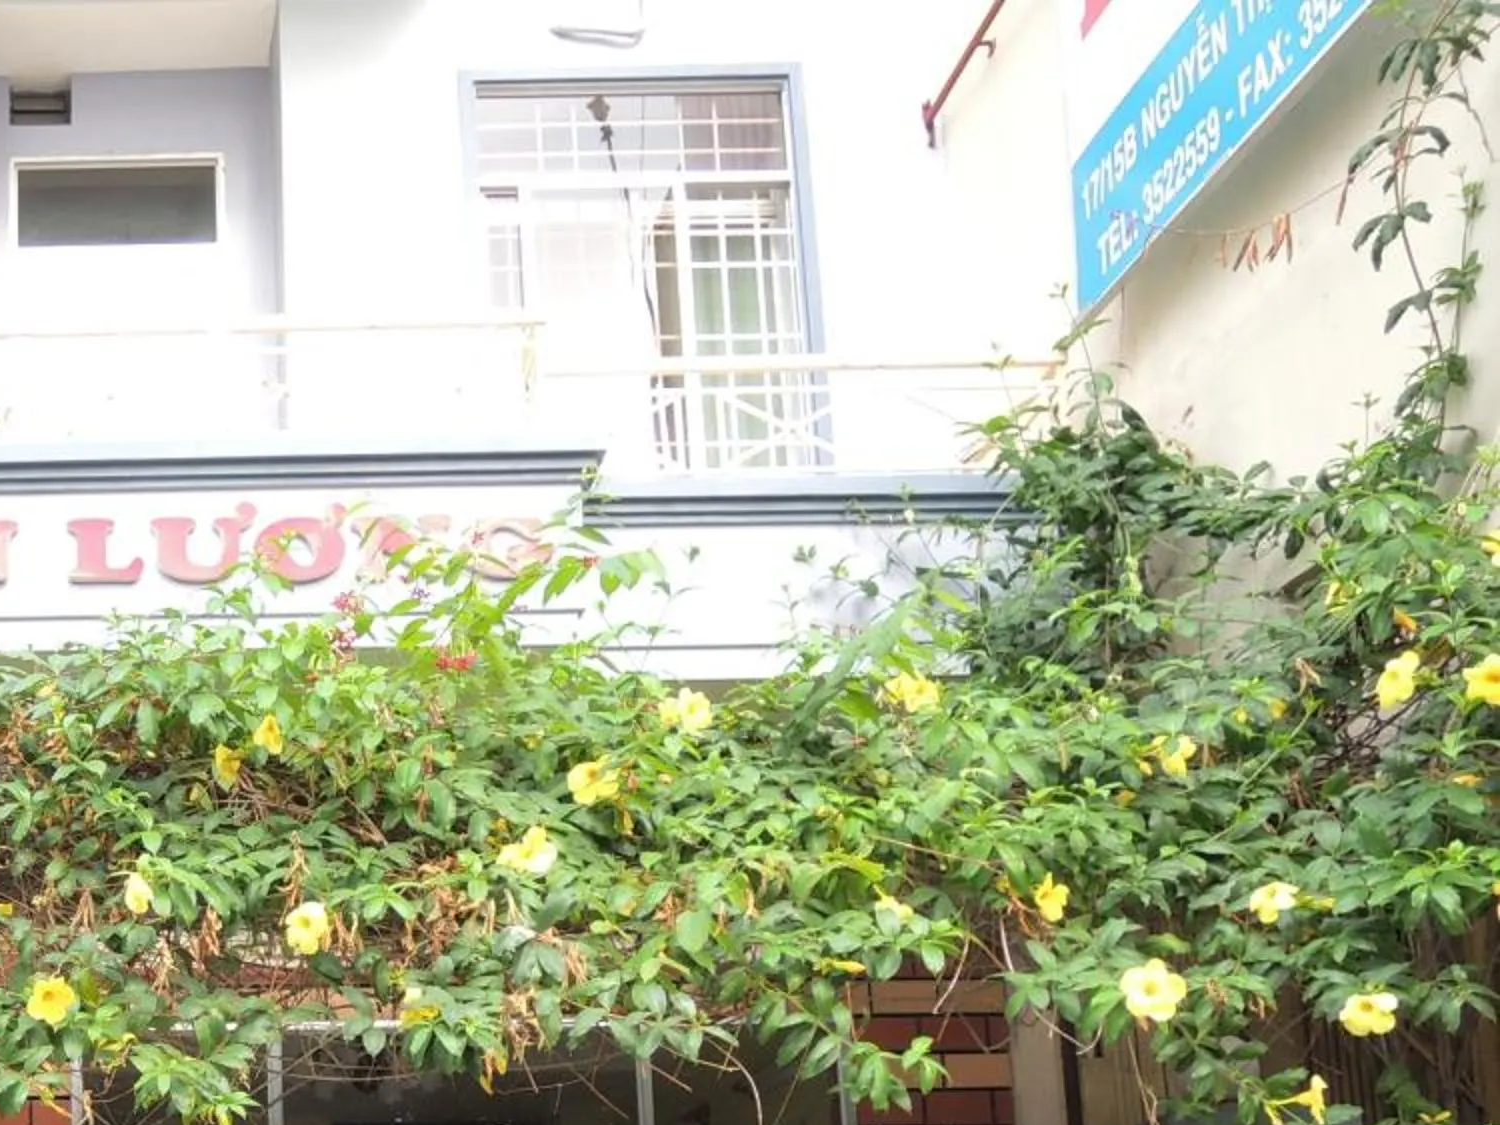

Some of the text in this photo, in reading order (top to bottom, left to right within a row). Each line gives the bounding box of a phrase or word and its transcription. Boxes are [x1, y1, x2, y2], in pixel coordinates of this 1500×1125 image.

[1082, 123, 1137, 220] 17/15B
[1141, 106, 1221, 224] 3522559
[1237, 29, 1294, 119] FAX:
